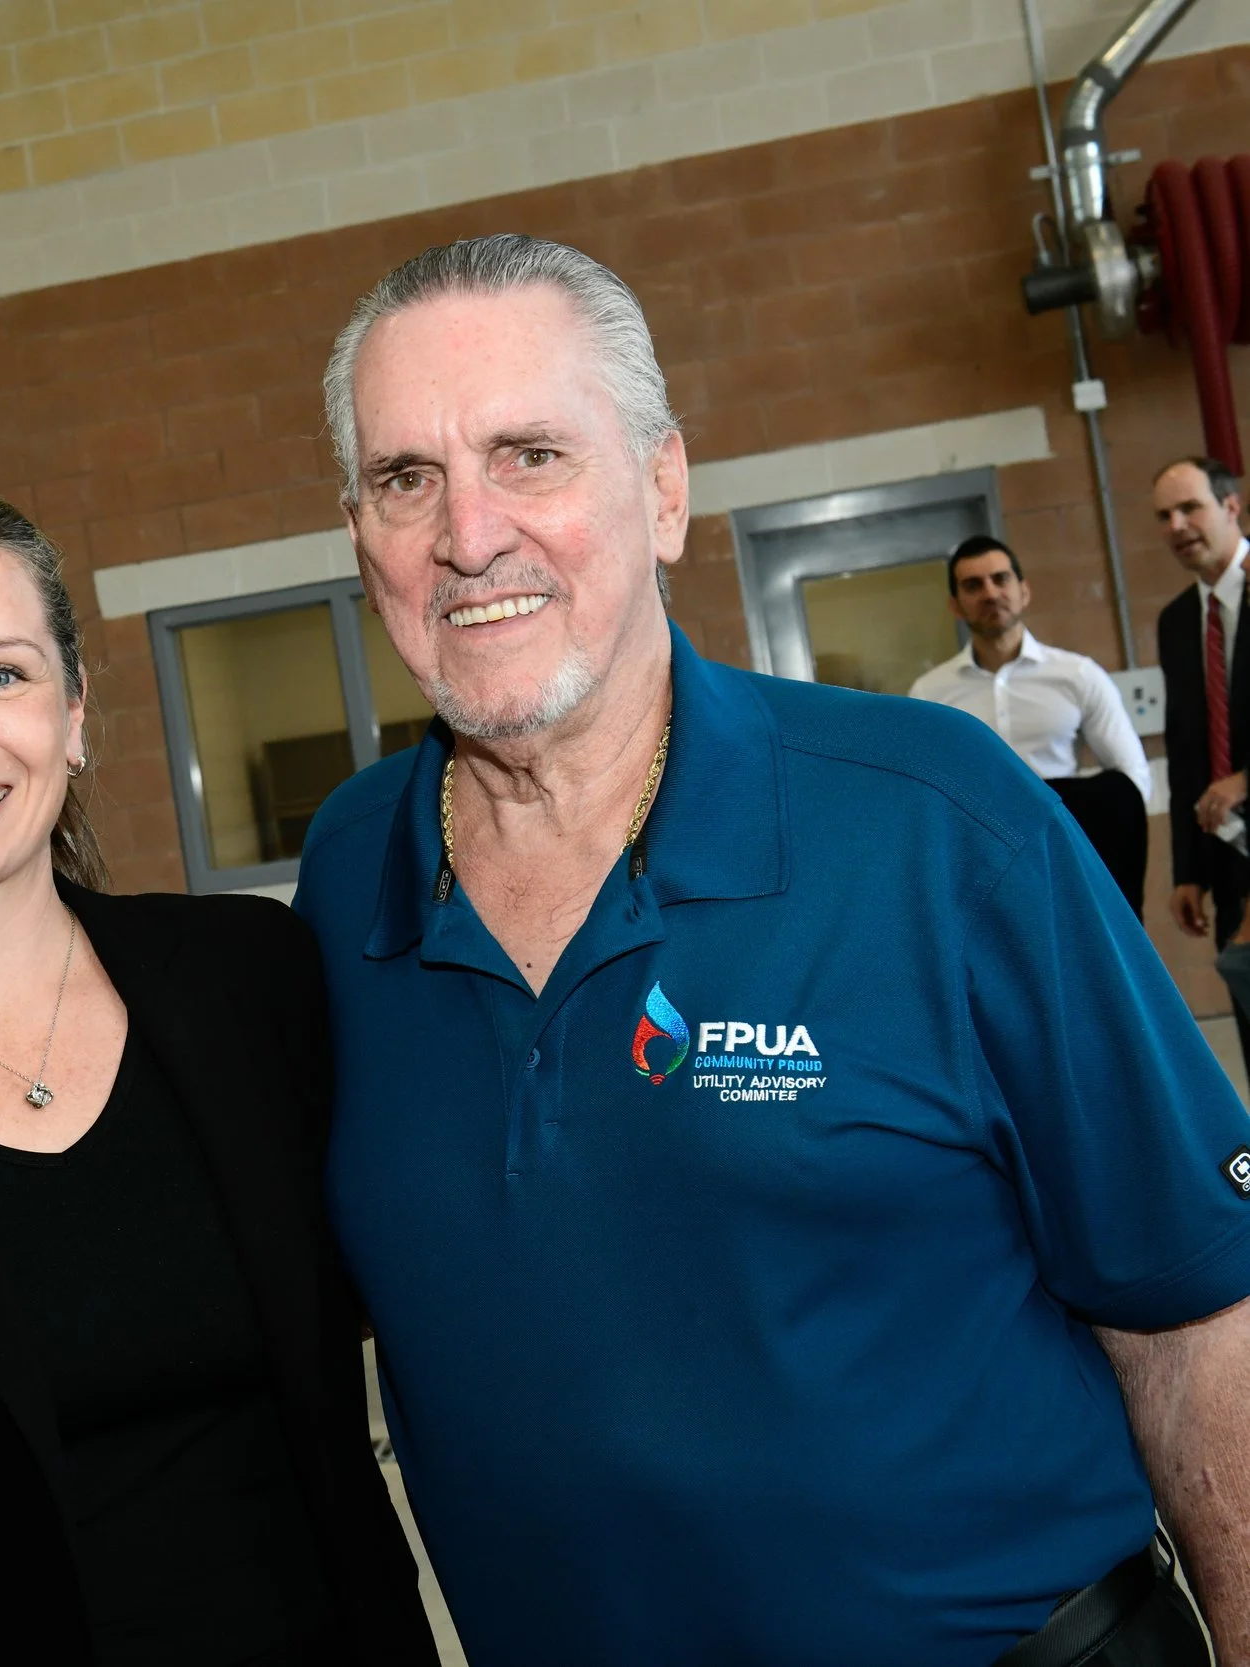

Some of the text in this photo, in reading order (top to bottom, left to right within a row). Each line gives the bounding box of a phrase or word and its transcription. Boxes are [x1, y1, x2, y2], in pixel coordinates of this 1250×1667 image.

[697, 1021, 820, 1057] FPUA
[694, 1055, 823, 1071] COMMUNITY PROUD
[693, 1074, 827, 1089] UTILITY ADVISORY
[720, 1089, 798, 1102] COMMITEE
